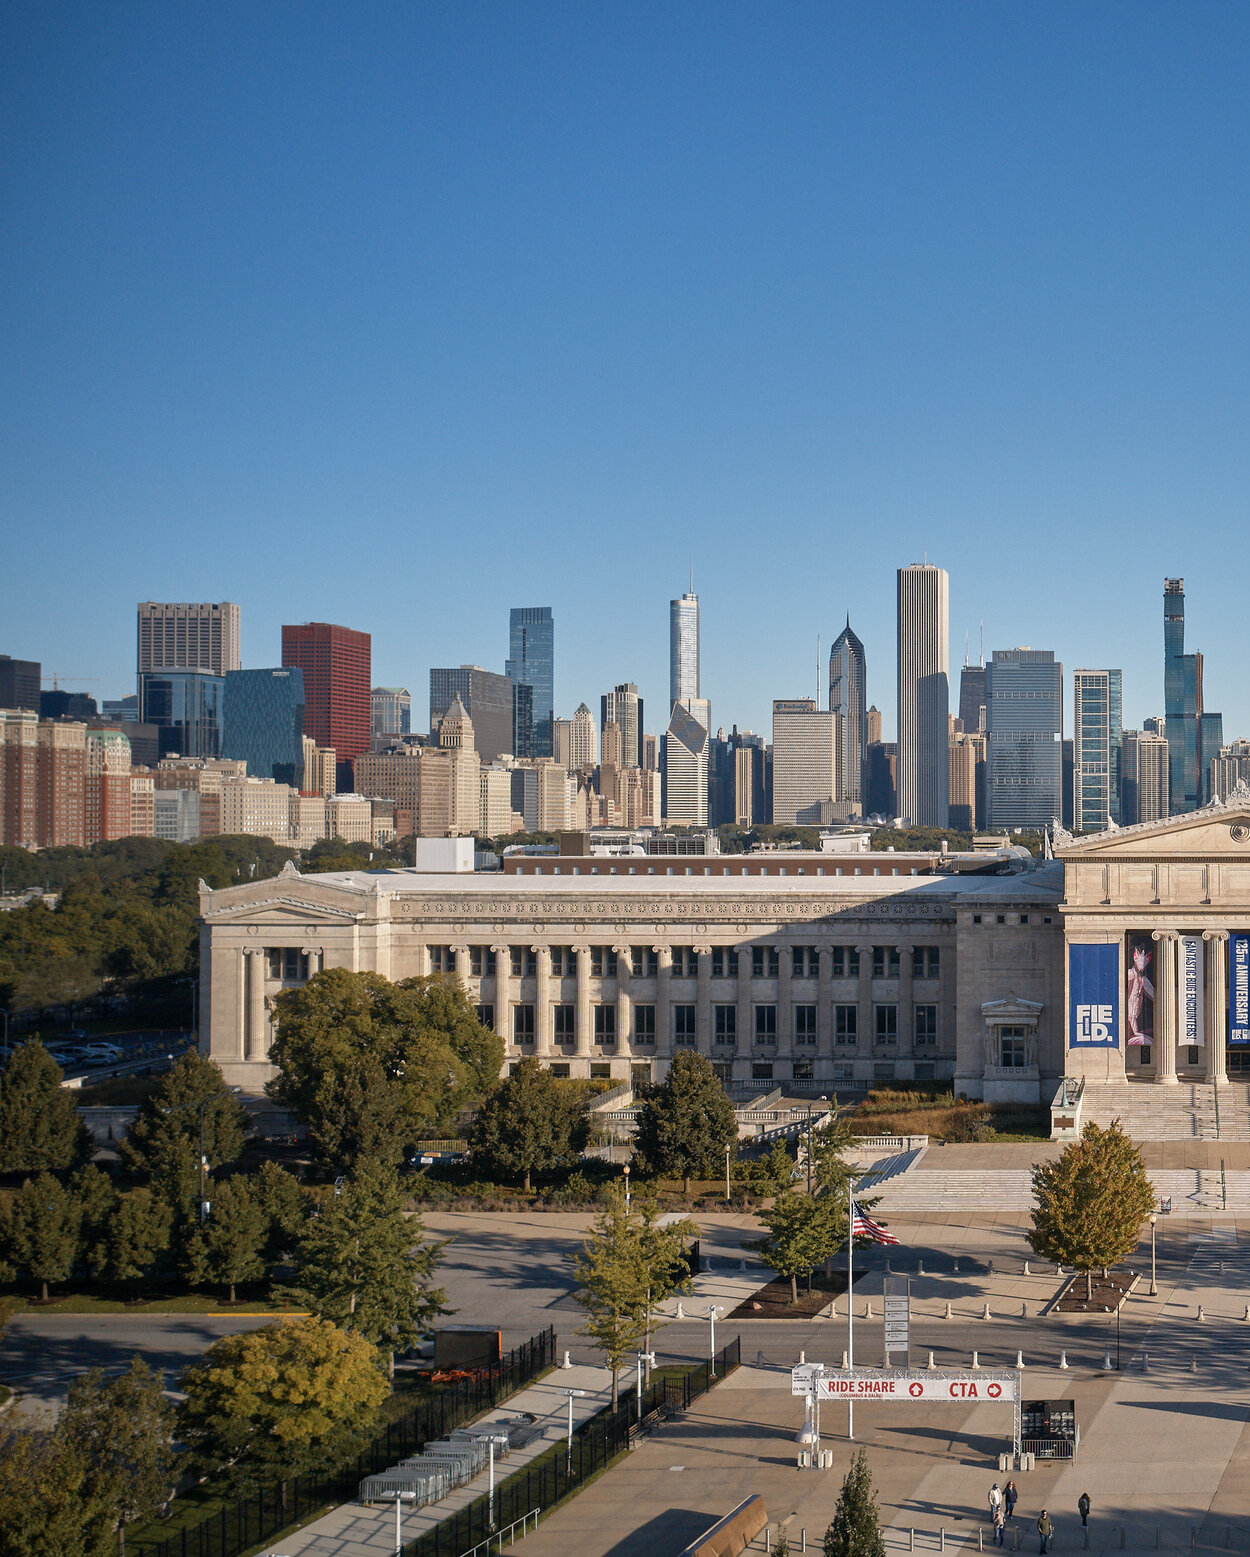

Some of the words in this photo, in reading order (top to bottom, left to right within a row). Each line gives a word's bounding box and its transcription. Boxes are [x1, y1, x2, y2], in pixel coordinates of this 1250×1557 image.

[1185, 941, 1197, 976] FANTASTIC
[1185, 978, 1197, 992] BUG
[1236, 964, 1248, 1025] ANNIVERSARY
[1186, 993, 1197, 1039] ENCOUNTERS!
[829, 1381, 855, 1392] RIDE
[858, 1381, 895, 1392] SHARE
[949, 1382, 978, 1397] CTA
